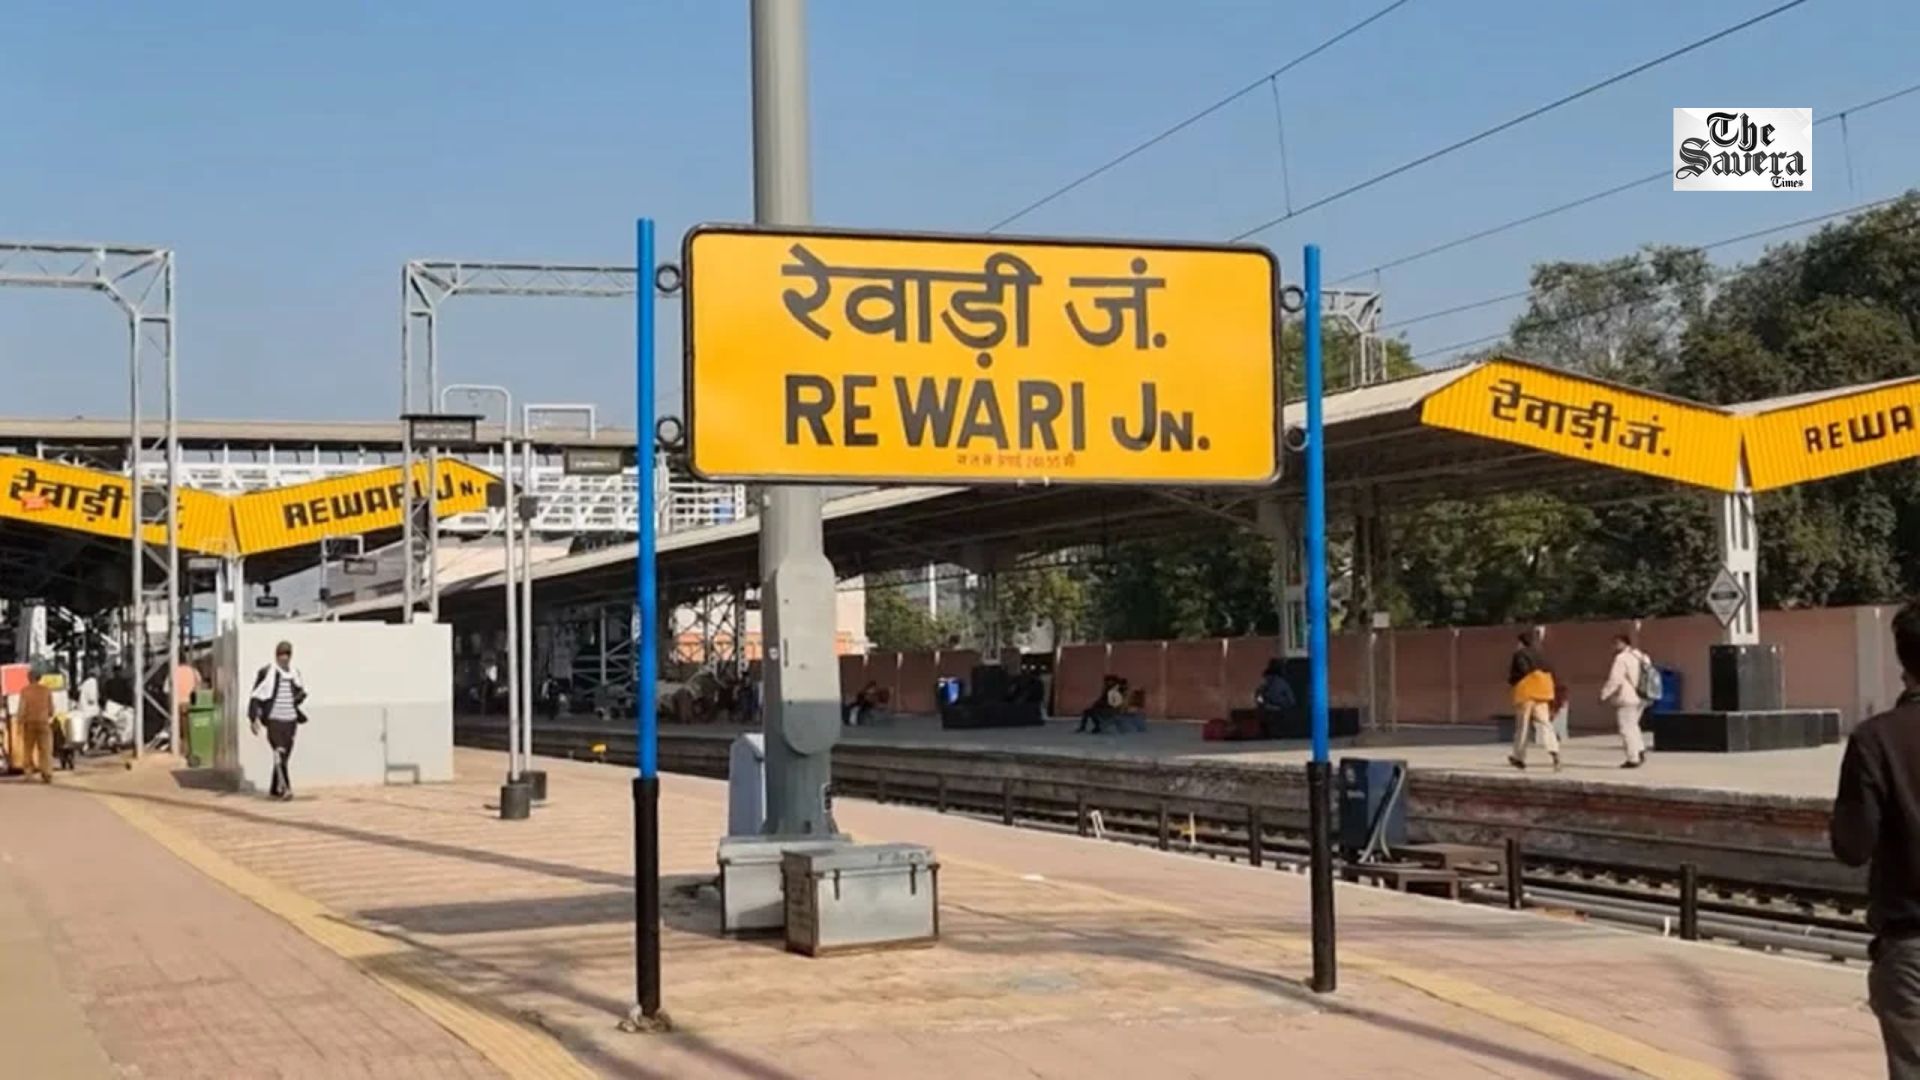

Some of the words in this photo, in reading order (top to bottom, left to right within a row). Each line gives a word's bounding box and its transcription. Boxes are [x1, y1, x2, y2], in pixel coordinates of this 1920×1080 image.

[781, 243, 1043, 369] रेवाड़ी
[1064, 257, 1167, 350] जं.
[784, 374, 1086, 451] REWARI
[1488, 378, 1620, 450] रेवाड़ी
